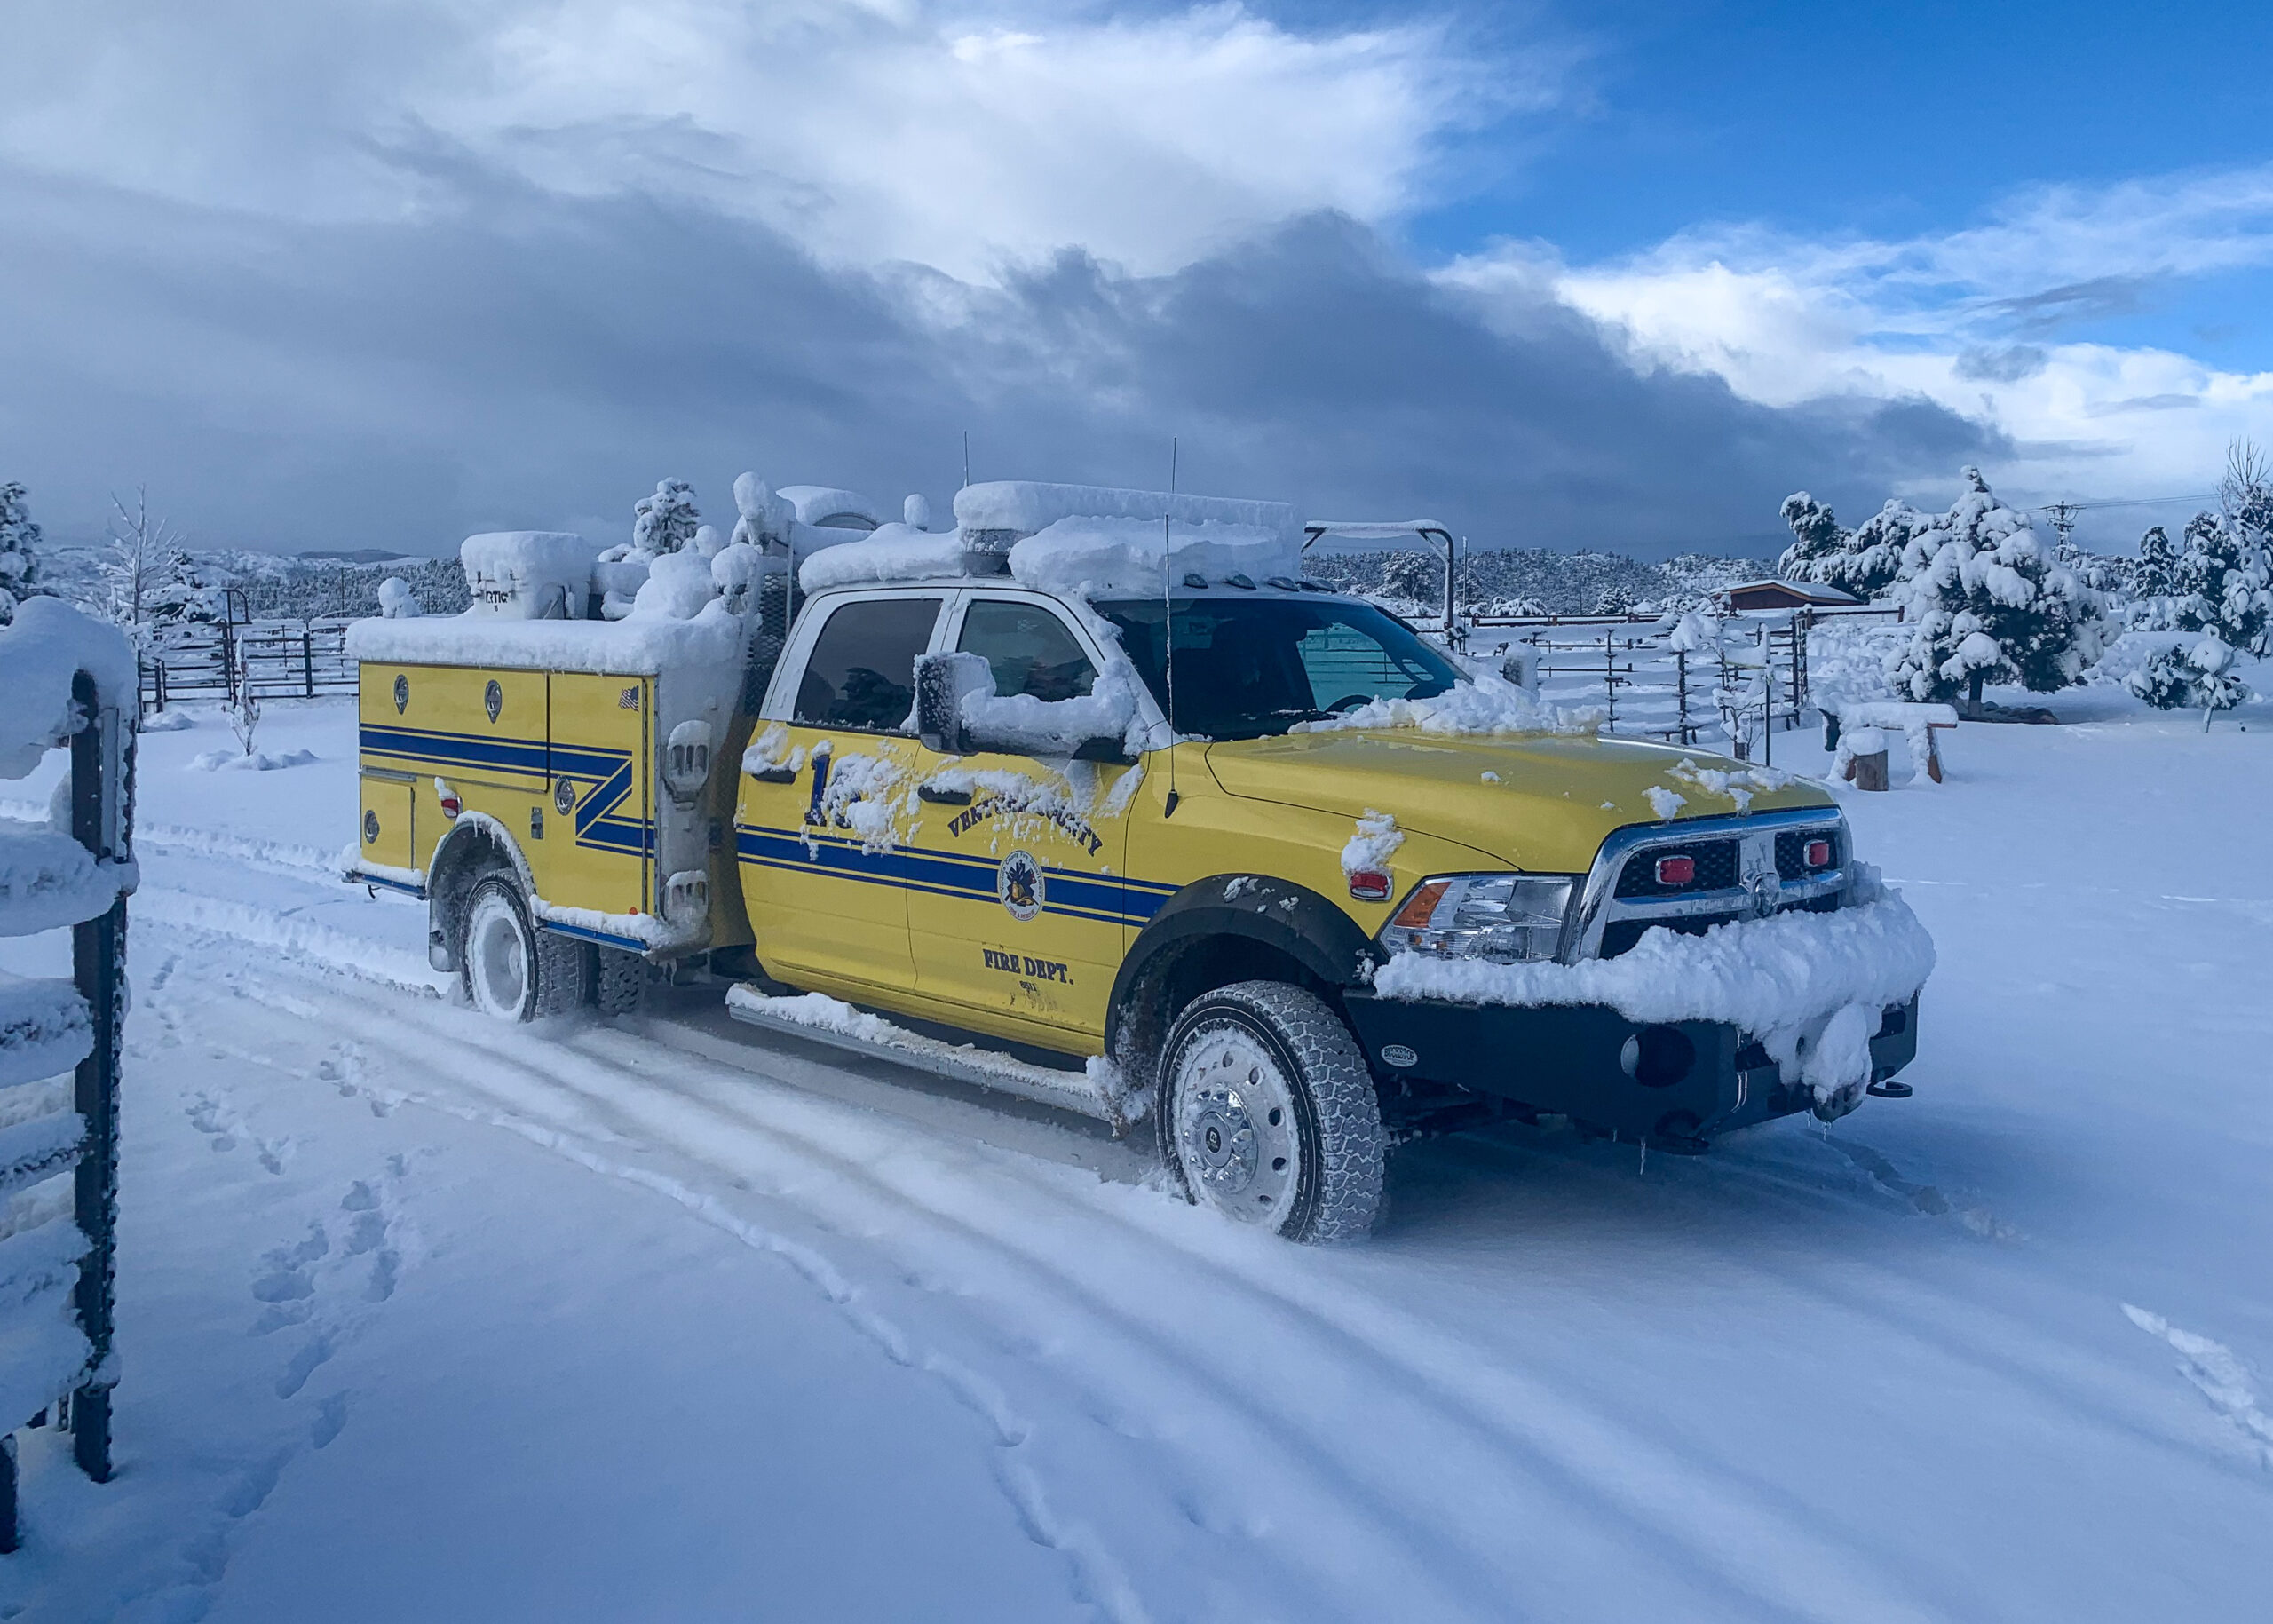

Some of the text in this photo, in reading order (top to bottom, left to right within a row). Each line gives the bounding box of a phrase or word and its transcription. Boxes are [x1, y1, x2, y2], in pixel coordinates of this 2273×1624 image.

[486, 590, 508, 604] RTIC
[983, 948, 1074, 985] FIRE DEPT.
